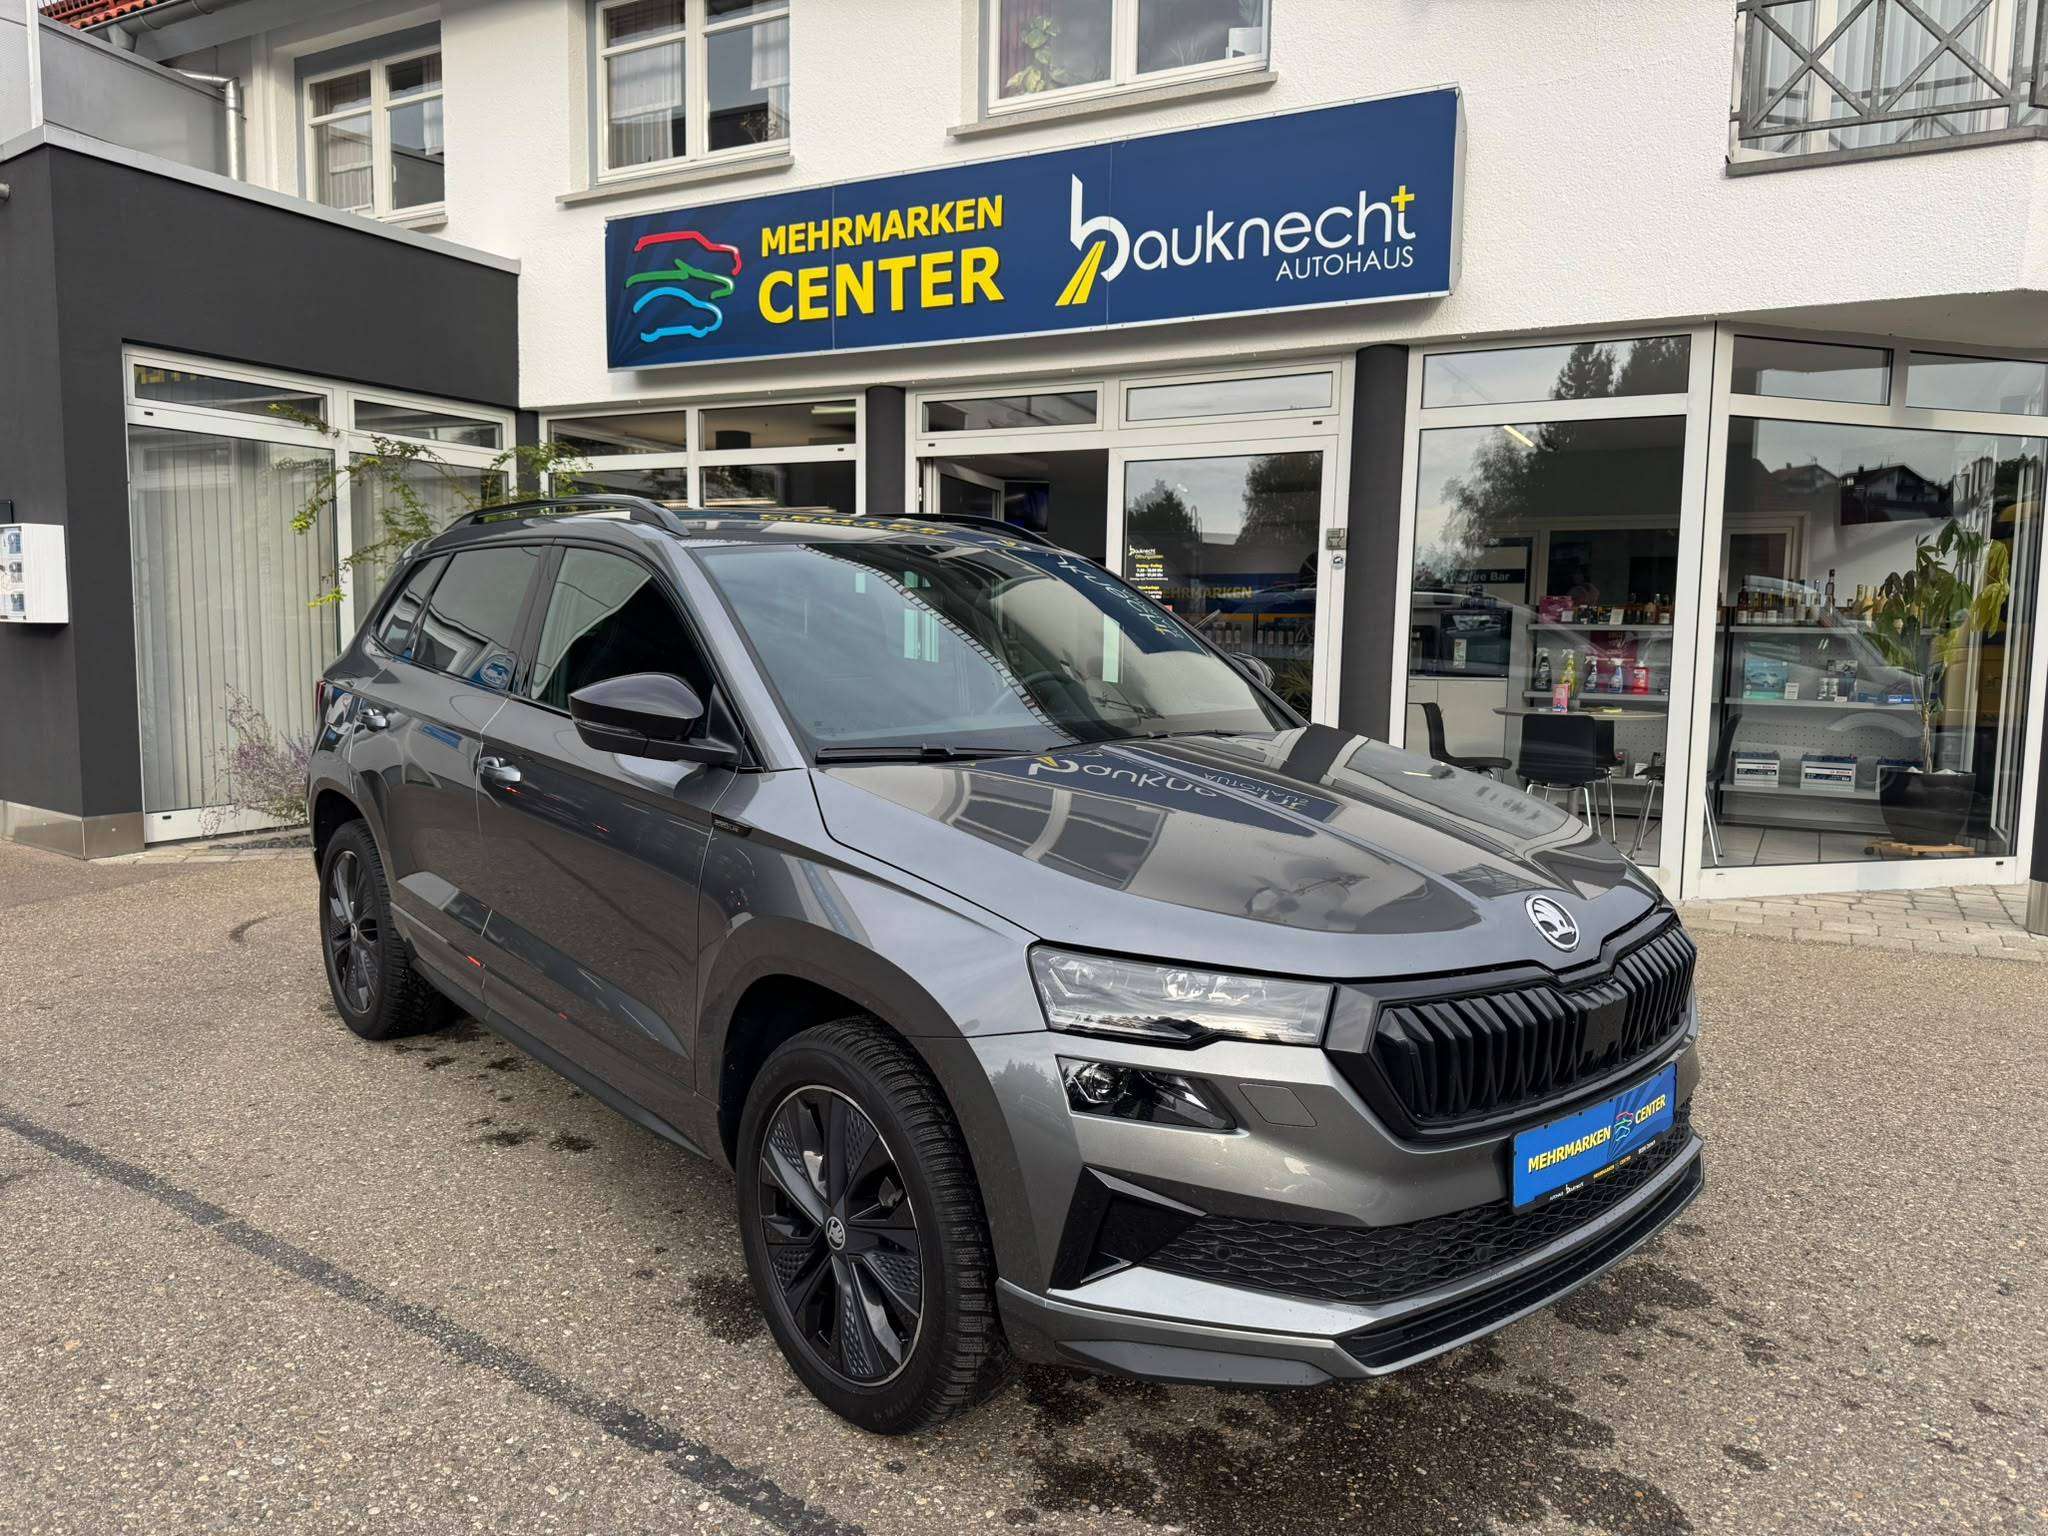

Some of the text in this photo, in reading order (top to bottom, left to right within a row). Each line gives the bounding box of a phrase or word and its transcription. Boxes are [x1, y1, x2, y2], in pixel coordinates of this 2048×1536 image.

[759, 196, 1003, 258] MEHRMARKEN
[757, 247, 1005, 324] CENTER
[1275, 245, 1415, 282] AUTOHAUS
[1490, 570, 1511, 582] Bar
[1528, 1094, 1667, 1173] MEHRMARKEN CENTER
